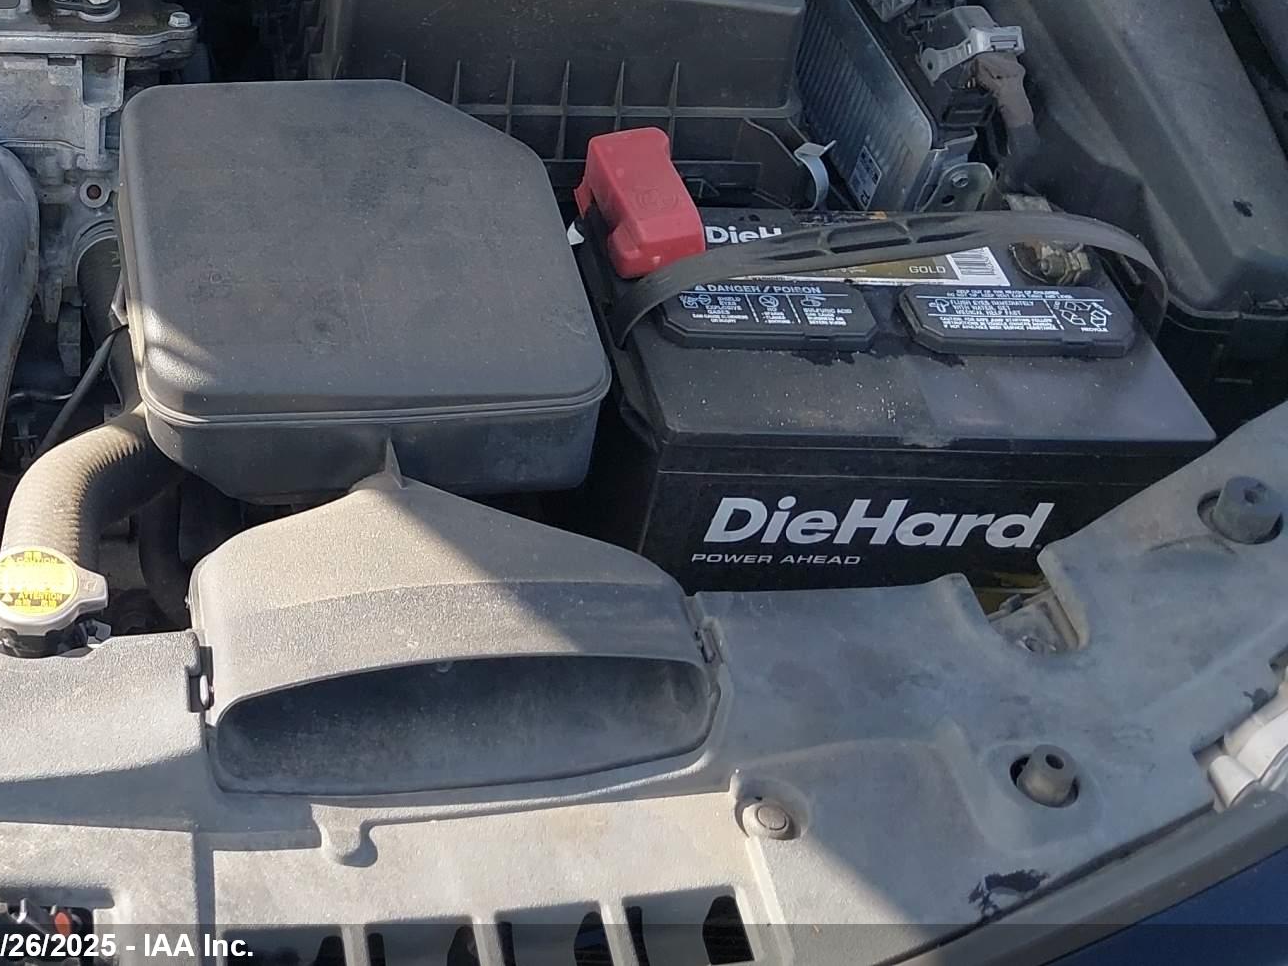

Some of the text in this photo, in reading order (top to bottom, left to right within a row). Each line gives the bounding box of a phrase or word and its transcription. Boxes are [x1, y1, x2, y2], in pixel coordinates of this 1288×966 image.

[908, 264, 947, 275] GOLD
[707, 284, 761, 293] DANGER
[772, 286, 822, 294] POISON
[703, 495, 1055, 549] DieHard
[690, 552, 861, 566] POWER AHEAD
